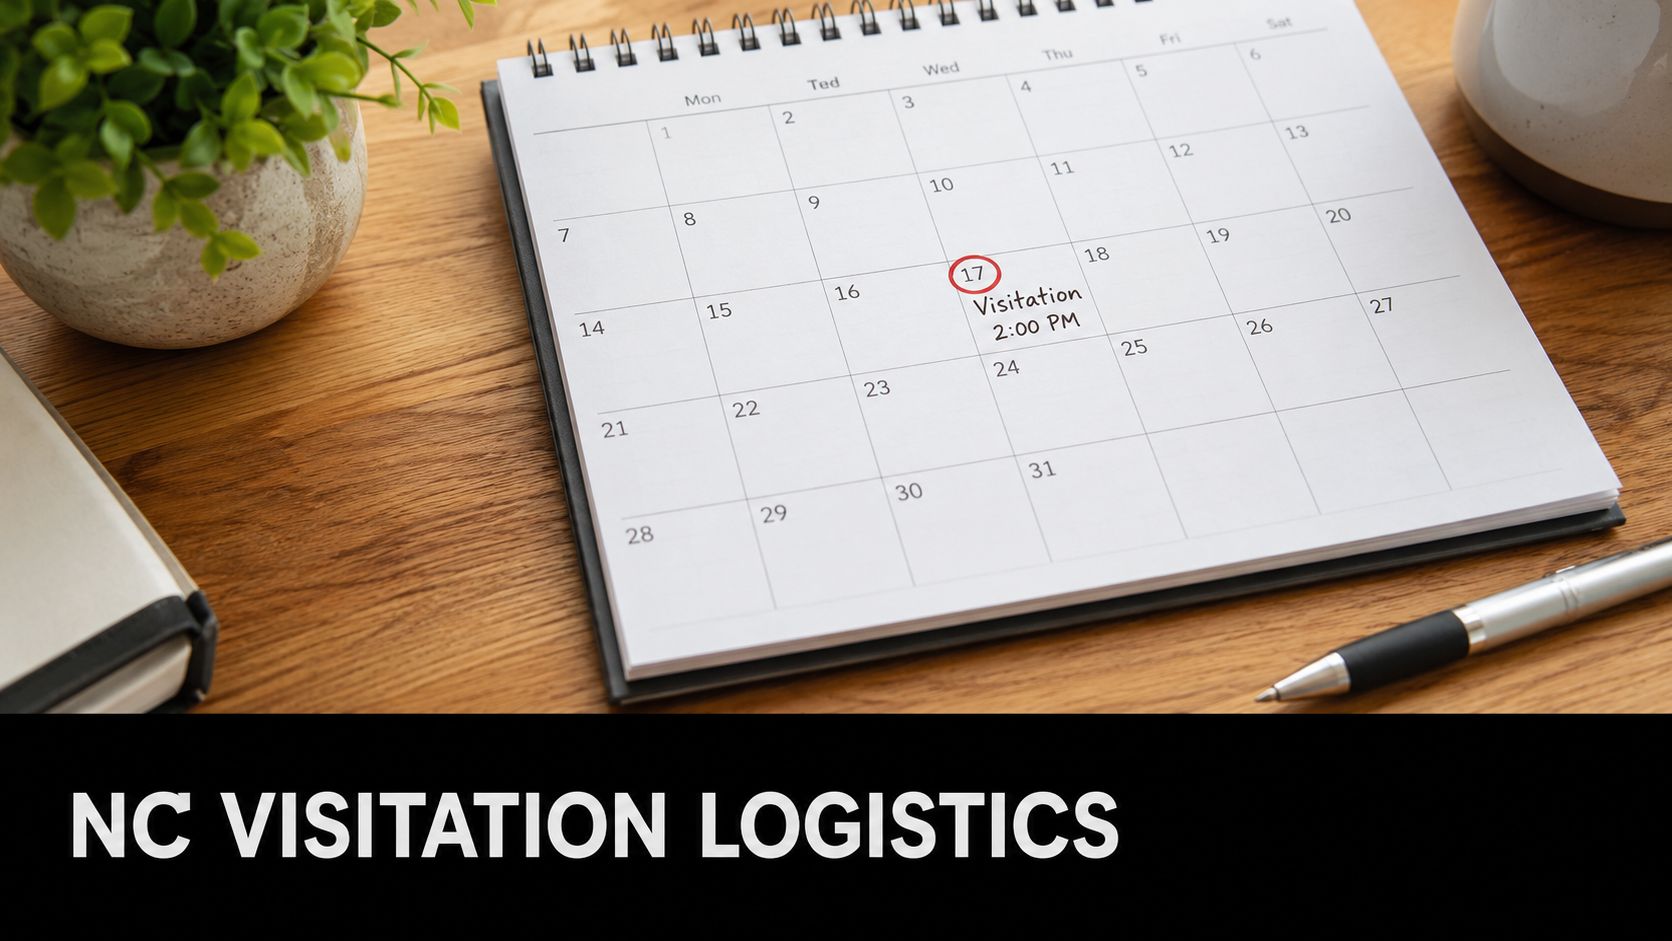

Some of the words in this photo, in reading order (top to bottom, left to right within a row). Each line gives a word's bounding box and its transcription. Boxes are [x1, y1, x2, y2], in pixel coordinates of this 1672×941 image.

[661, 126, 671, 140] 1
[782, 110, 796, 125] 2
[901, 95, 915, 109] 3
[1020, 80, 1032, 93] 4
[1135, 63, 1148, 78] 5
[1249, 47, 1262, 61] 6
[684, 94, 722, 107] Mon
[807, 76, 841, 91] Ted
[922, 61, 960, 77] Wed
[1041, 48, 1074, 61] Thu
[1159, 32, 1182, 46] Fri
[1266, 16, 1293, 30] Sat
[557, 227, 570, 243] 7
[683, 211, 697, 227] 8
[808, 195, 820, 210] 9
[929, 177, 954, 193] 10
[1050, 160, 1075, 176] 11
[1169, 143, 1194, 159] 12
[1285, 124, 1310, 140] 13
[579, 320, 605, 338] 14
[706, 302, 732, 320] 15
[834, 284, 860, 301] 16
[960, 265, 983, 283] 17
[1084, 246, 1110, 263] 18
[1206, 227, 1230, 244] 19
[1325, 207, 1352, 224] 20
[973, 287, 1082, 316] Visitation
[601, 420, 629, 439] 21
[732, 400, 761, 419] 22
[863, 379, 891, 398] 23
[993, 359, 1020, 378] 24
[1120, 338, 1148, 357] 25
[1246, 318, 1274, 336] 26
[1369, 296, 1392, 314] 27
[993, 320, 1040, 341] 2:00
[1047, 312, 1081, 331] PM
[625, 525, 655, 545] 28
[760, 504, 787, 524] 29
[895, 482, 923, 502] 30
[1028, 460, 1057, 479] 31
